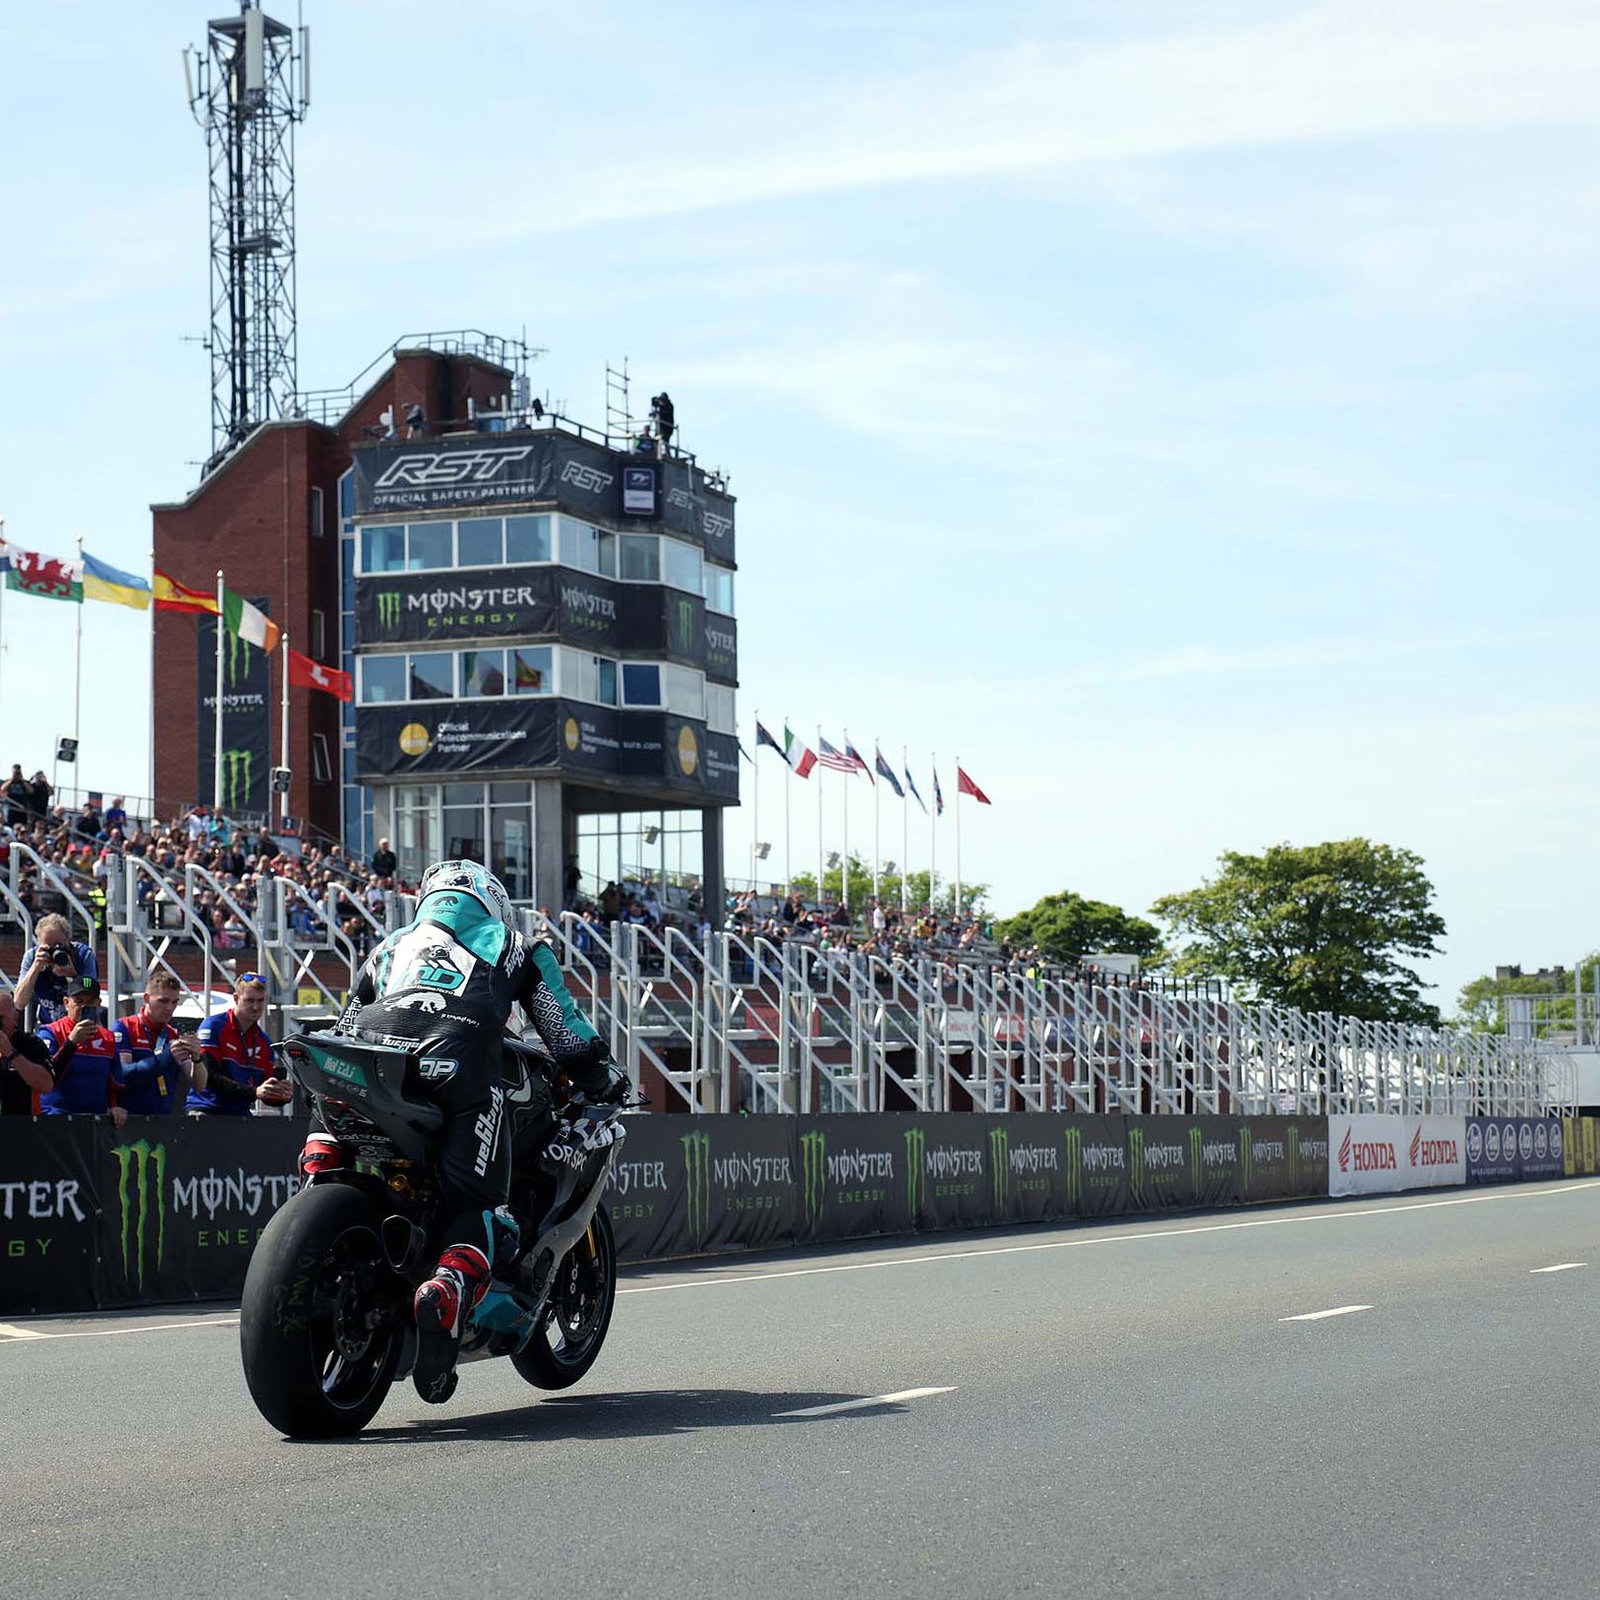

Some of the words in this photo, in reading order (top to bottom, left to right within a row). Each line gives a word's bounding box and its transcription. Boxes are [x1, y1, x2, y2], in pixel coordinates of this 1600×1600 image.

[374, 445, 534, 487] RST
[561, 460, 613, 494] RST
[373, 493, 428, 505] OFFICIAL
[432, 489, 477, 501] SAFETY
[481, 485, 535, 498] PARTNER
[703, 511, 733, 537] ST
[407, 586, 536, 614] MONSTER
[561, 585, 617, 620] MONSTER
[427, 613, 517, 627] ENERGY
[438, 722, 469, 732] Official
[438, 744, 470, 753] Partner
[623, 741, 662, 750] sure.com
[926, 1145, 983, 1179] MONSTER
[1009, 1143, 1058, 1175] MONSTER
[1082, 1142, 1126, 1172] MONSTER
[1144, 1142, 1184, 1169] MONSTER
[1203, 1139, 1237, 1167] MONSTER
[1252, 1138, 1285, 1166] MONSTER
[1352, 1142, 1397, 1171] HONDA
[1421, 1140, 1458, 1166] HONDA
[605, 1160, 667, 1195] NSTER
[714, 1151, 792, 1190] MONSTER
[827, 1148, 894, 1186] MONSTER
[173, 1168, 300, 1220] MONSTE
[726, 1195, 782, 1211] ENERGY
[838, 1189, 887, 1204] ENERGY
[612, 1204, 655, 1220] ERGY
[198, 1228, 264, 1247] ENE
